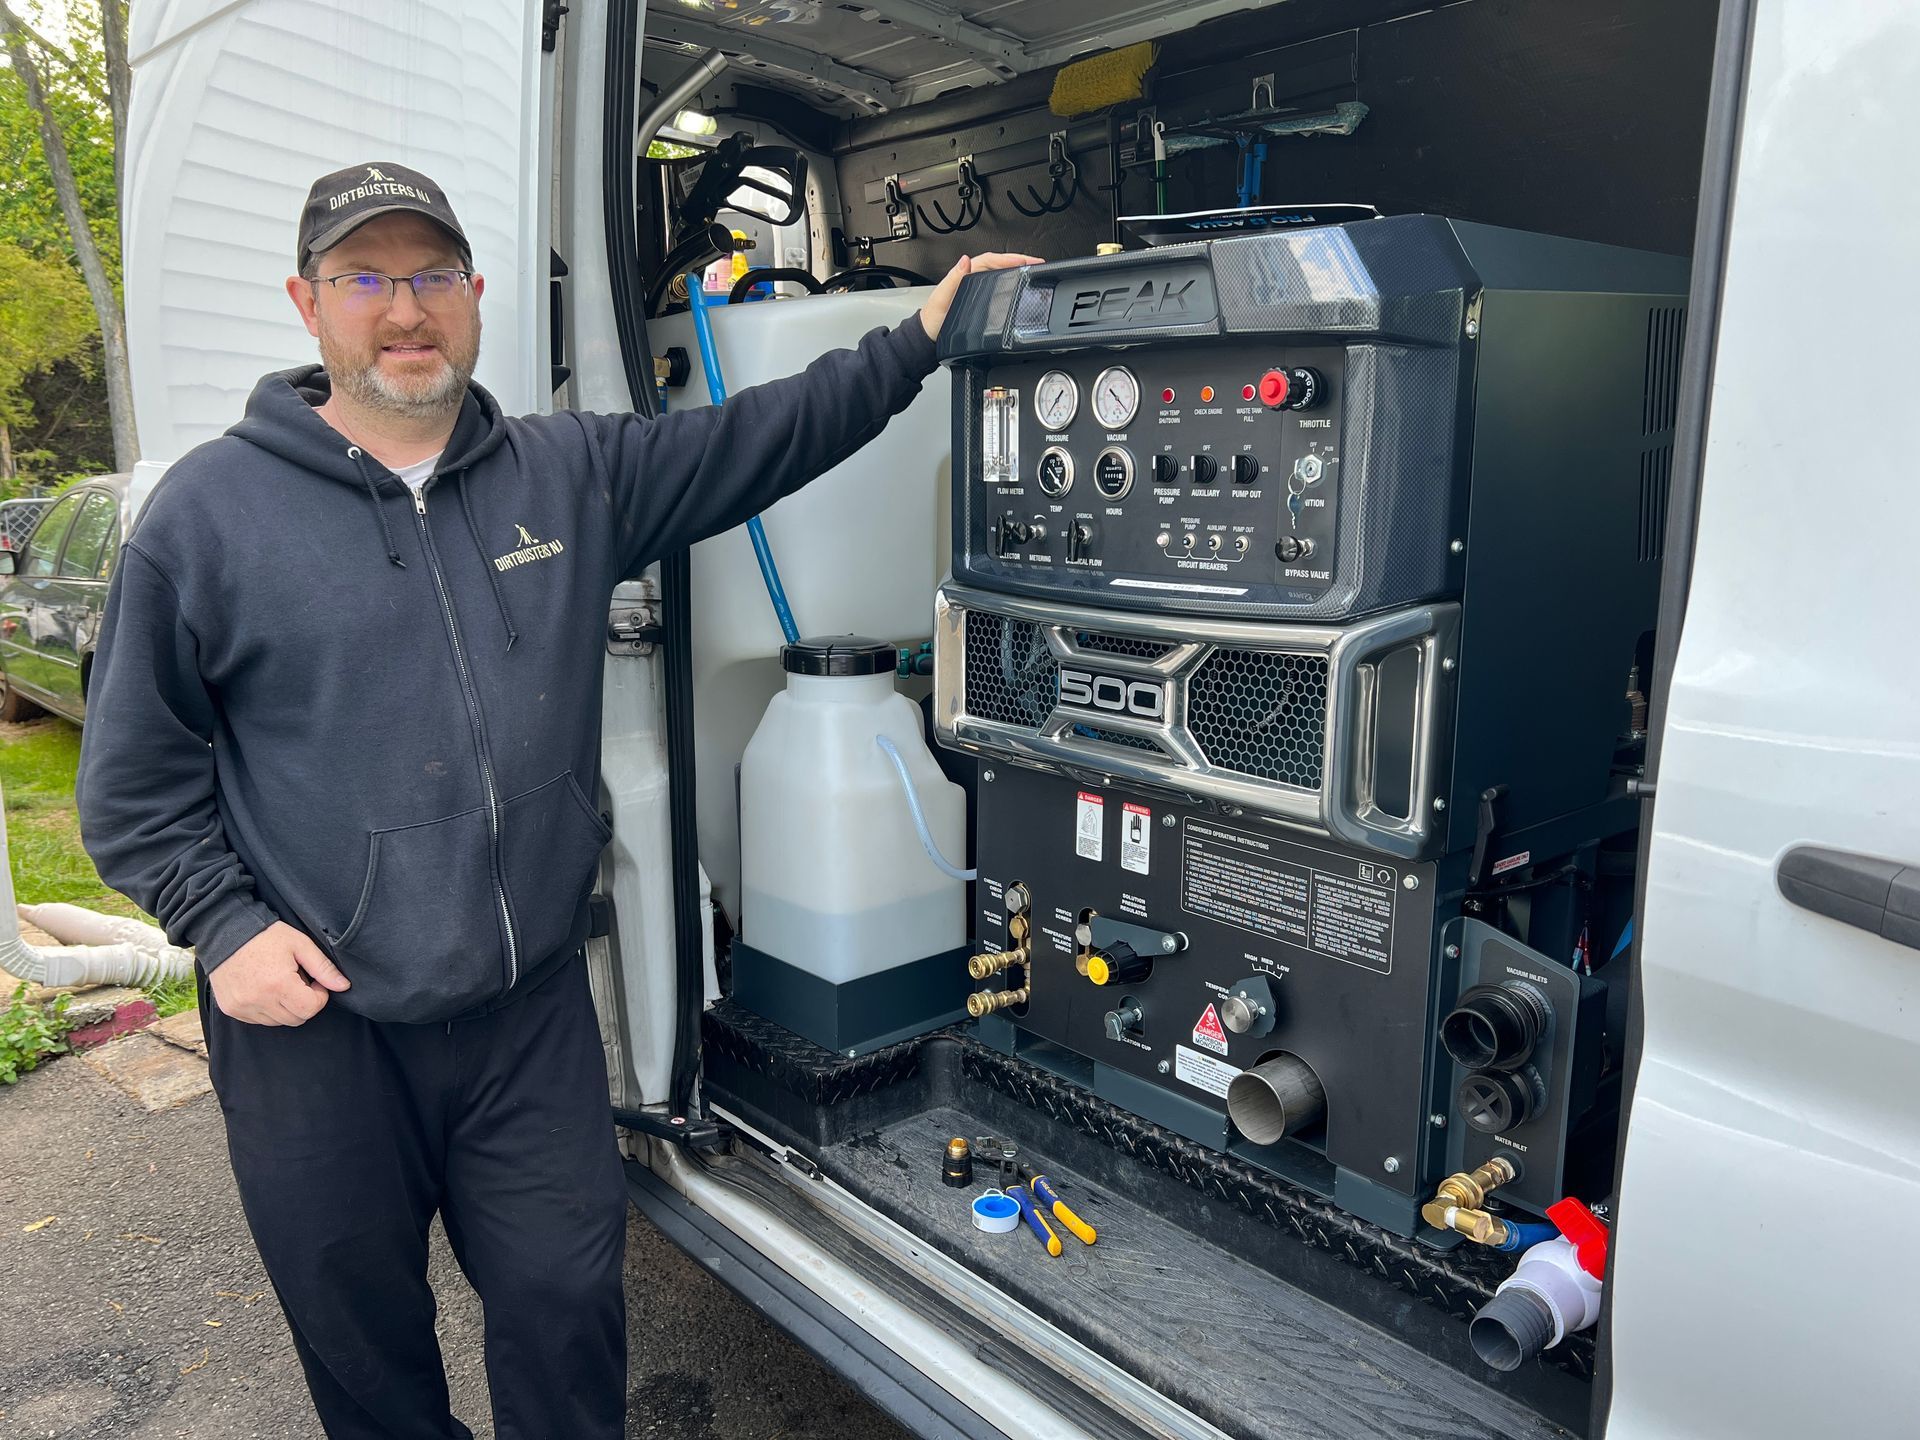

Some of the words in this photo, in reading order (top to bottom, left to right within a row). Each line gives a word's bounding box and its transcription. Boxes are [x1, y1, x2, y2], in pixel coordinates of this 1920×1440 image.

[330, 183, 414, 210] DIRTBUSTERS
[416, 188, 431, 204] NJ
[1070, 280, 1195, 321] PEAK
[1301, 388, 1312, 406] LOCK
[1300, 420, 1331, 428] THROTTLE
[1154, 488, 1180, 496] PRESSURE
[1191, 489, 1220, 497] AUXILIARY
[494, 544, 552, 572] DIRTBUSTERS
[551, 539, 564, 555] NJ
[1029, 554, 1051, 562] METERING
[1177, 561, 1198, 570] CIRCUIT
[1199, 562, 1228, 571] BREAKERS
[1285, 569, 1309, 578] BYPASS
[1310, 571, 1329, 579] VALVE
[1061, 670, 1163, 717] 500
[1186, 824, 1211, 836] CONDENSED
[1212, 830, 1236, 842] OPERATING
[1237, 836, 1269, 850] INSTRUCTIONS
[1122, 893, 1146, 905] SOLUTION
[1122, 899, 1146, 911] PRESSURE
[1120, 905, 1148, 918] REGULATOR
[1042, 927, 1072, 942] TEMPERATURE
[1244, 953, 1258, 962] HIGH
[1261, 957, 1273, 965] MED
[1277, 964, 1290, 973] LOW
[1506, 966, 1528, 979] VACUUM
[1529, 973, 1548, 984] INLETS
[1198, 1025, 1222, 1040] DANGER
[1195, 1038, 1226, 1053] MONOXIDE
[1198, 1034, 1222, 1047] CARBON
[1494, 1134, 1512, 1147] WATER
[1513, 1140, 1528, 1152] INLET
